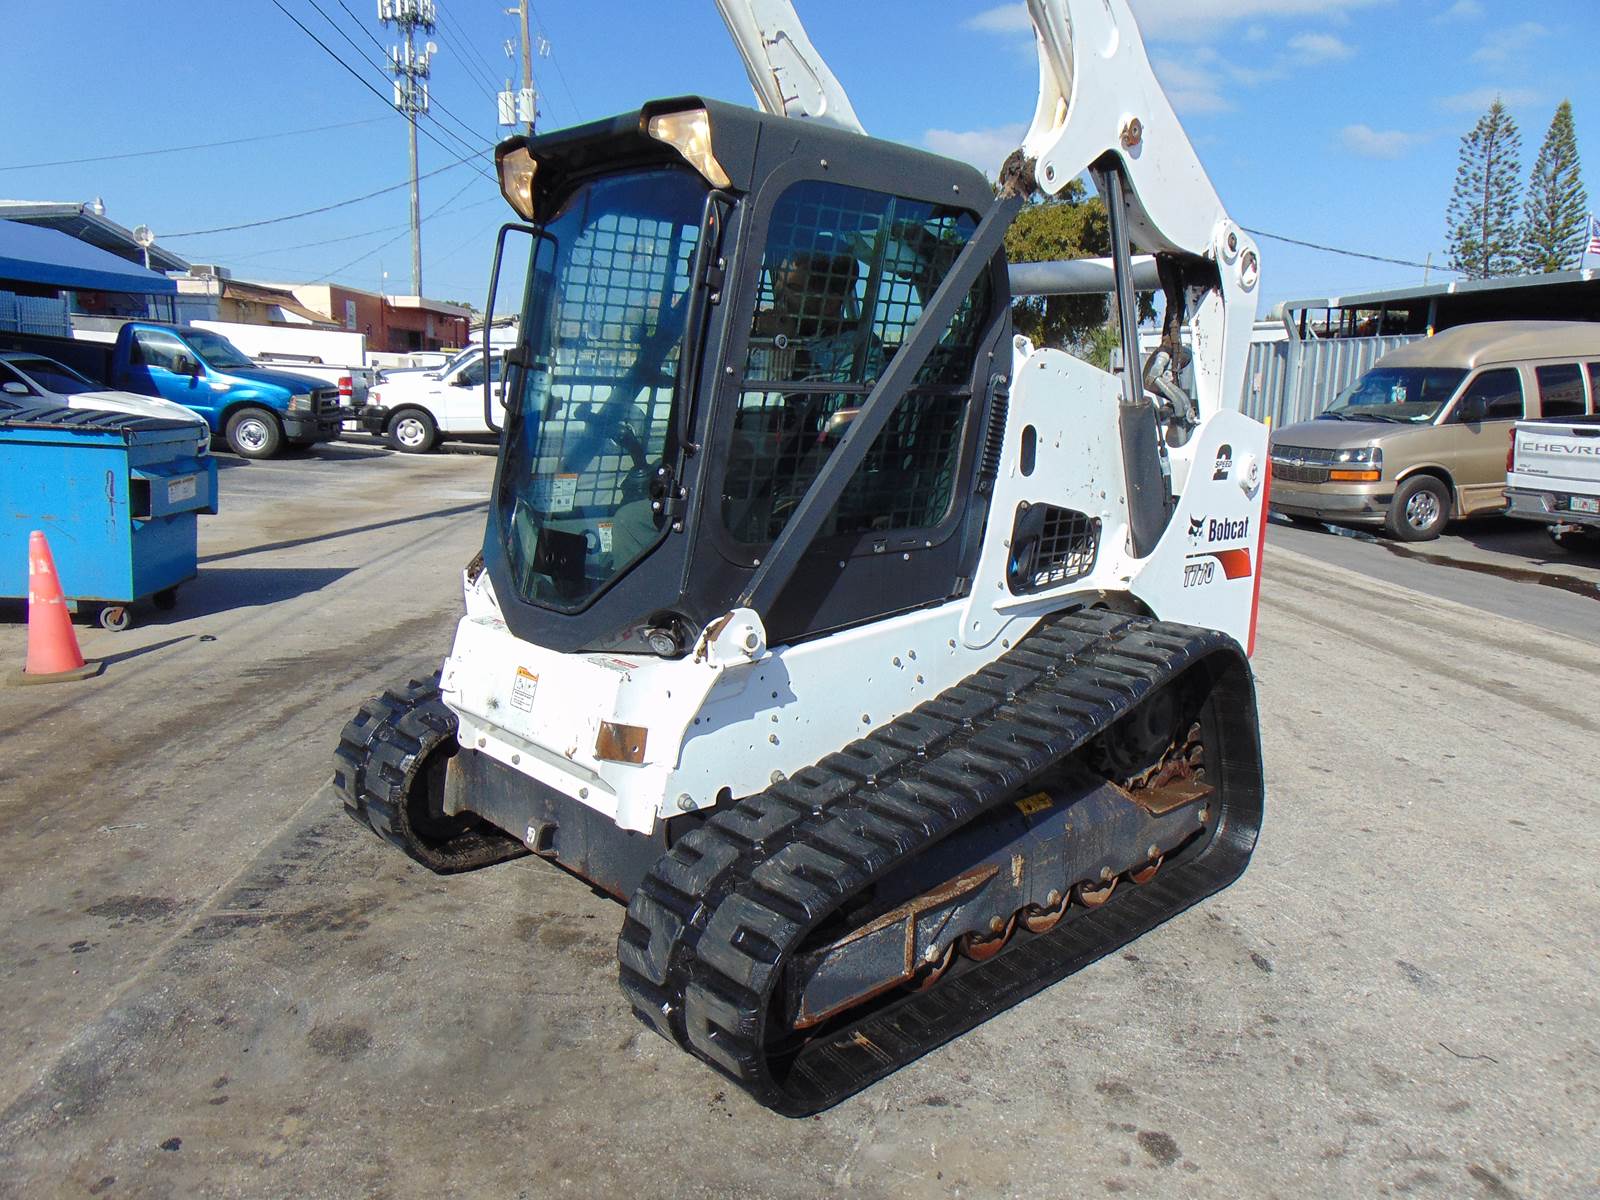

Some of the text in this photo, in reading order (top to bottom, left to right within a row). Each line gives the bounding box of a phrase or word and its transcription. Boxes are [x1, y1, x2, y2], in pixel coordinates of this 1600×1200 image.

[1212, 444, 1233, 480] 2
[1214, 460, 1233, 469] SPEED
[1208, 516, 1249, 542] Bobcat
[1184, 562, 1215, 588] T770
